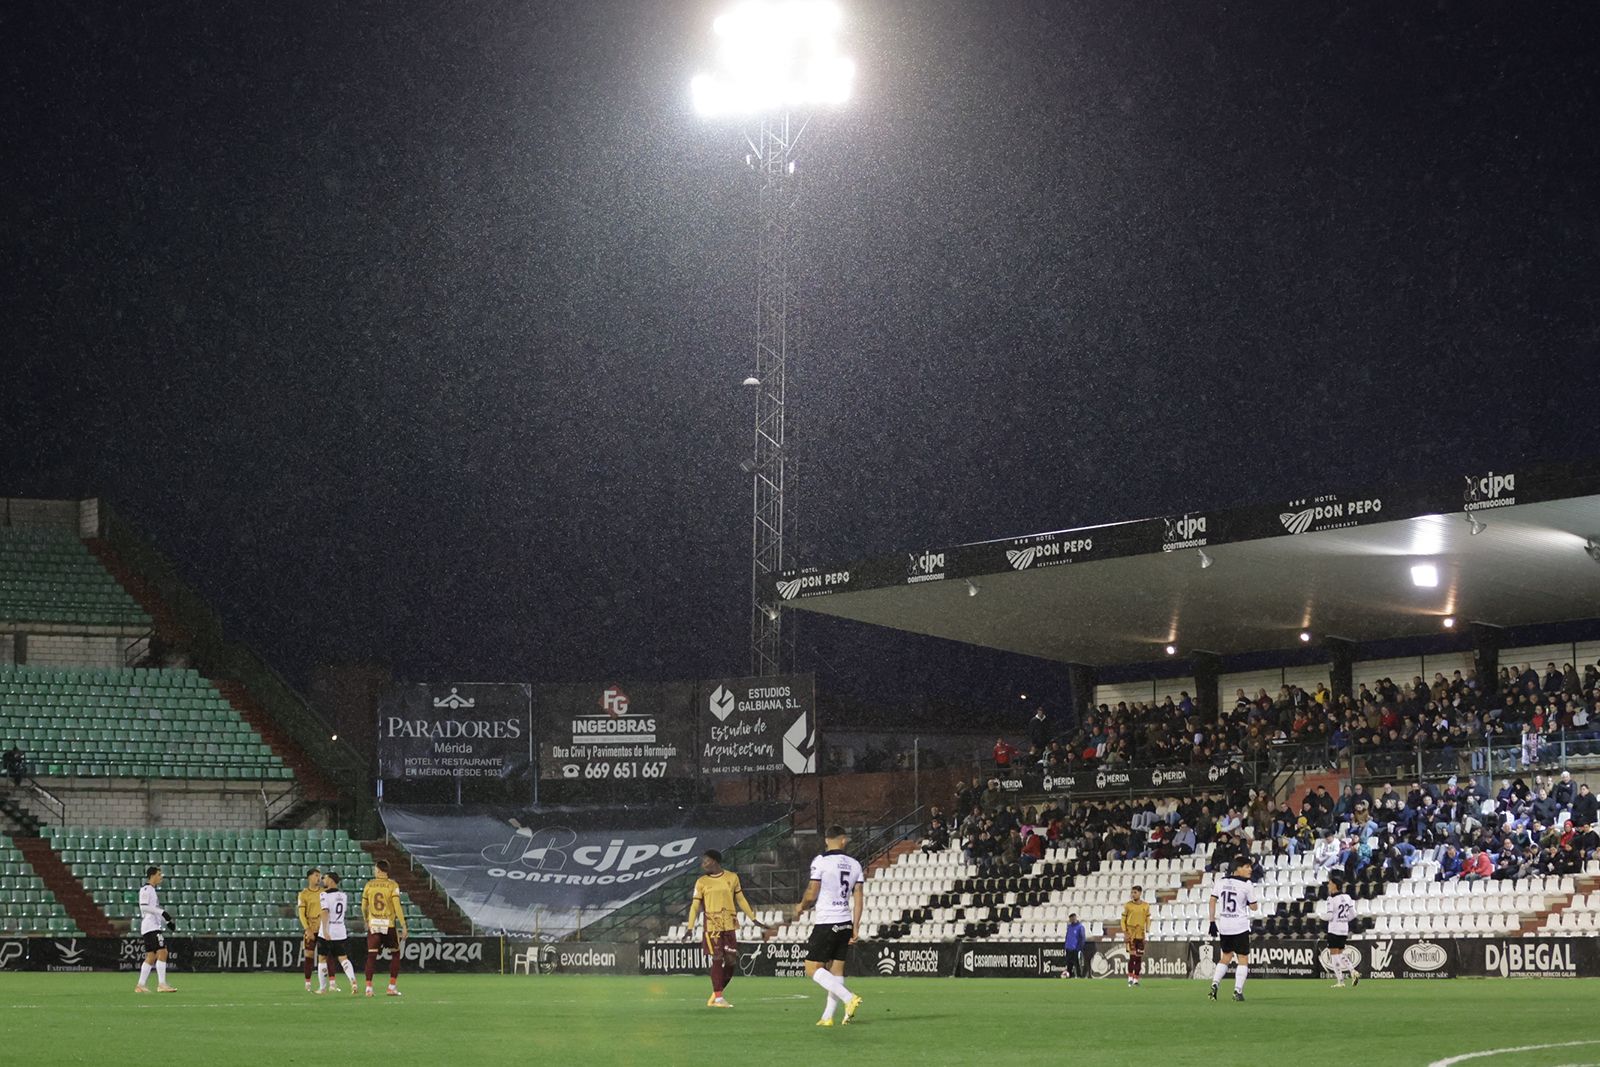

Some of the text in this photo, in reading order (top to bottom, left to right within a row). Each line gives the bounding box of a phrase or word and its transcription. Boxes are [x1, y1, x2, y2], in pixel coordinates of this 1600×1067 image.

[1479, 471, 1515, 499] cjpa
[1315, 499, 1382, 520] DON PEPO
[1176, 514, 1207, 540] cjpa
[1315, 521, 1358, 531] RESTAURANTE
[1036, 534, 1055, 542] HOTEL
[1036, 538, 1092, 557] DON PEPO
[919, 550, 945, 574] cjpa
[1037, 558, 1073, 567] RESTAURANTE
[801, 571, 850, 588] DON PEPO
[748, 686, 791, 699] ESTUDIOS
[603, 690, 628, 715] FG
[738, 698, 801, 712] GALBIANA, S.L.
[388, 717, 521, 739] PARADORES
[572, 719, 657, 733] INGEOBRAS
[711, 717, 767, 742] Estudio de
[434, 742, 473, 753] Mérida
[552, 743, 677, 760] Obra Civil y Pavimentos de Hormigón
[703, 742, 775, 763] Arquitectura
[441, 758, 502, 766] RESTAURANTE
[584, 762, 667, 778] 669 651 667
[405, 768, 417, 776] EN
[419, 767, 451, 776] MÉRIDA
[453, 768, 481, 776] DESDE
[1106, 773, 1130, 784] MÉRIDA
[1162, 770, 1187, 781] MÉRIDA
[1001, 779, 1023, 789] MÉRIDA
[1053, 777, 1075, 787] MÉRIDA
[572, 837, 698, 872] cjpa
[487, 856, 698, 886] CONSTRUCCIONES
[840, 870, 850, 899] 5
[374, 892, 385, 912] 6
[1220, 890, 1237, 913] 15
[335, 902, 344, 921] 9
[710, 930, 721, 938] 22
[560, 949, 616, 967] exaclean
[766, 944, 789, 959] Pedro
[899, 947, 938, 960] DIPUTACIÓN
[47, 964, 93, 972] Extremadura
[906, 962, 938, 972] BADAJOZ
[974, 954, 1008, 968] CASAMAYOR
[1009, 954, 1037, 968] PERFILES
[1148, 957, 1187, 974] Belinda
